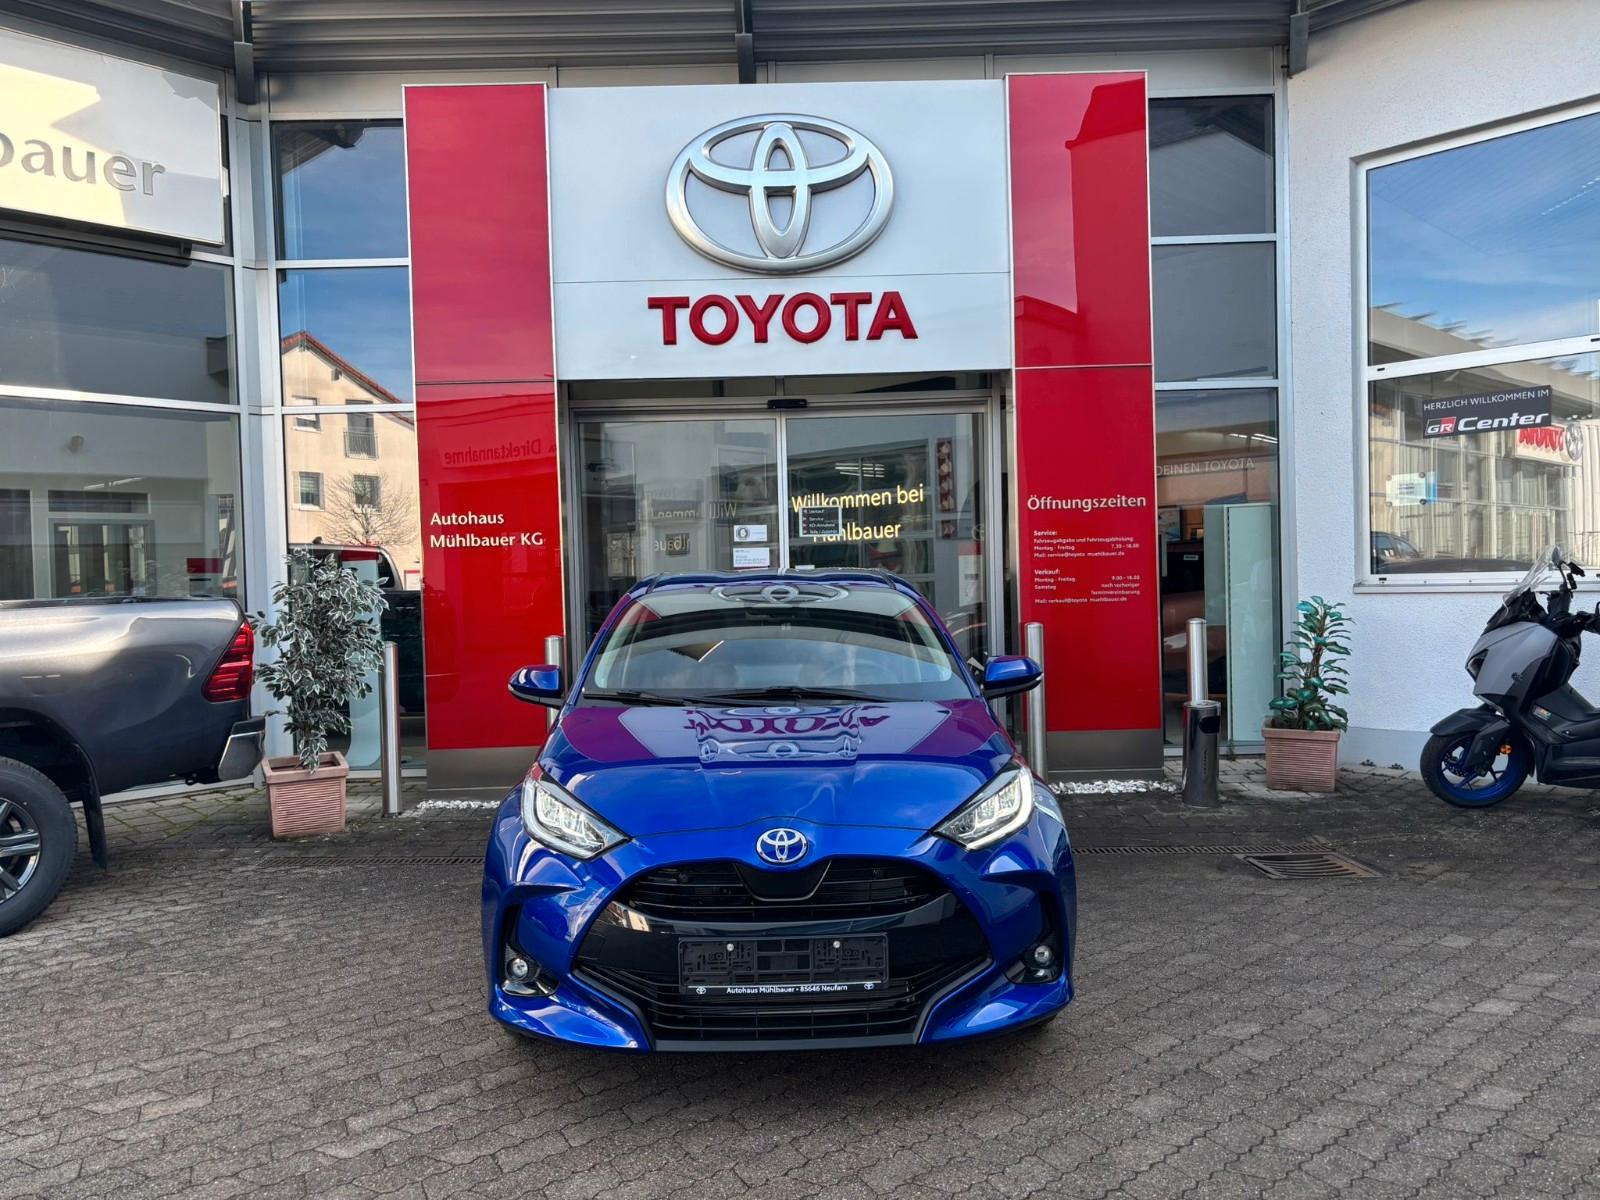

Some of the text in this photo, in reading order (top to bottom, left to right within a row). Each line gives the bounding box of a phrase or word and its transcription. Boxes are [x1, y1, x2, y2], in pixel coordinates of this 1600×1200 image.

[648, 291, 918, 345] TOYOTA
[1424, 389, 1549, 411] HERZLICH WILLKOMMEN IM
[1427, 412, 1549, 434] GR Center
[1204, 457, 1255, 472] TOYOTA
[897, 483, 923, 504] bei
[1027, 495, 1146, 512] Öffnungszeiten
[430, 511, 505, 526] Autohaus
[430, 532, 544, 548] Mühlbauer KG
[726, 986, 758, 994] Autohaus
[759, 985, 795, 994] Mühlbauer
[821, 983, 848, 992] Neufarn
